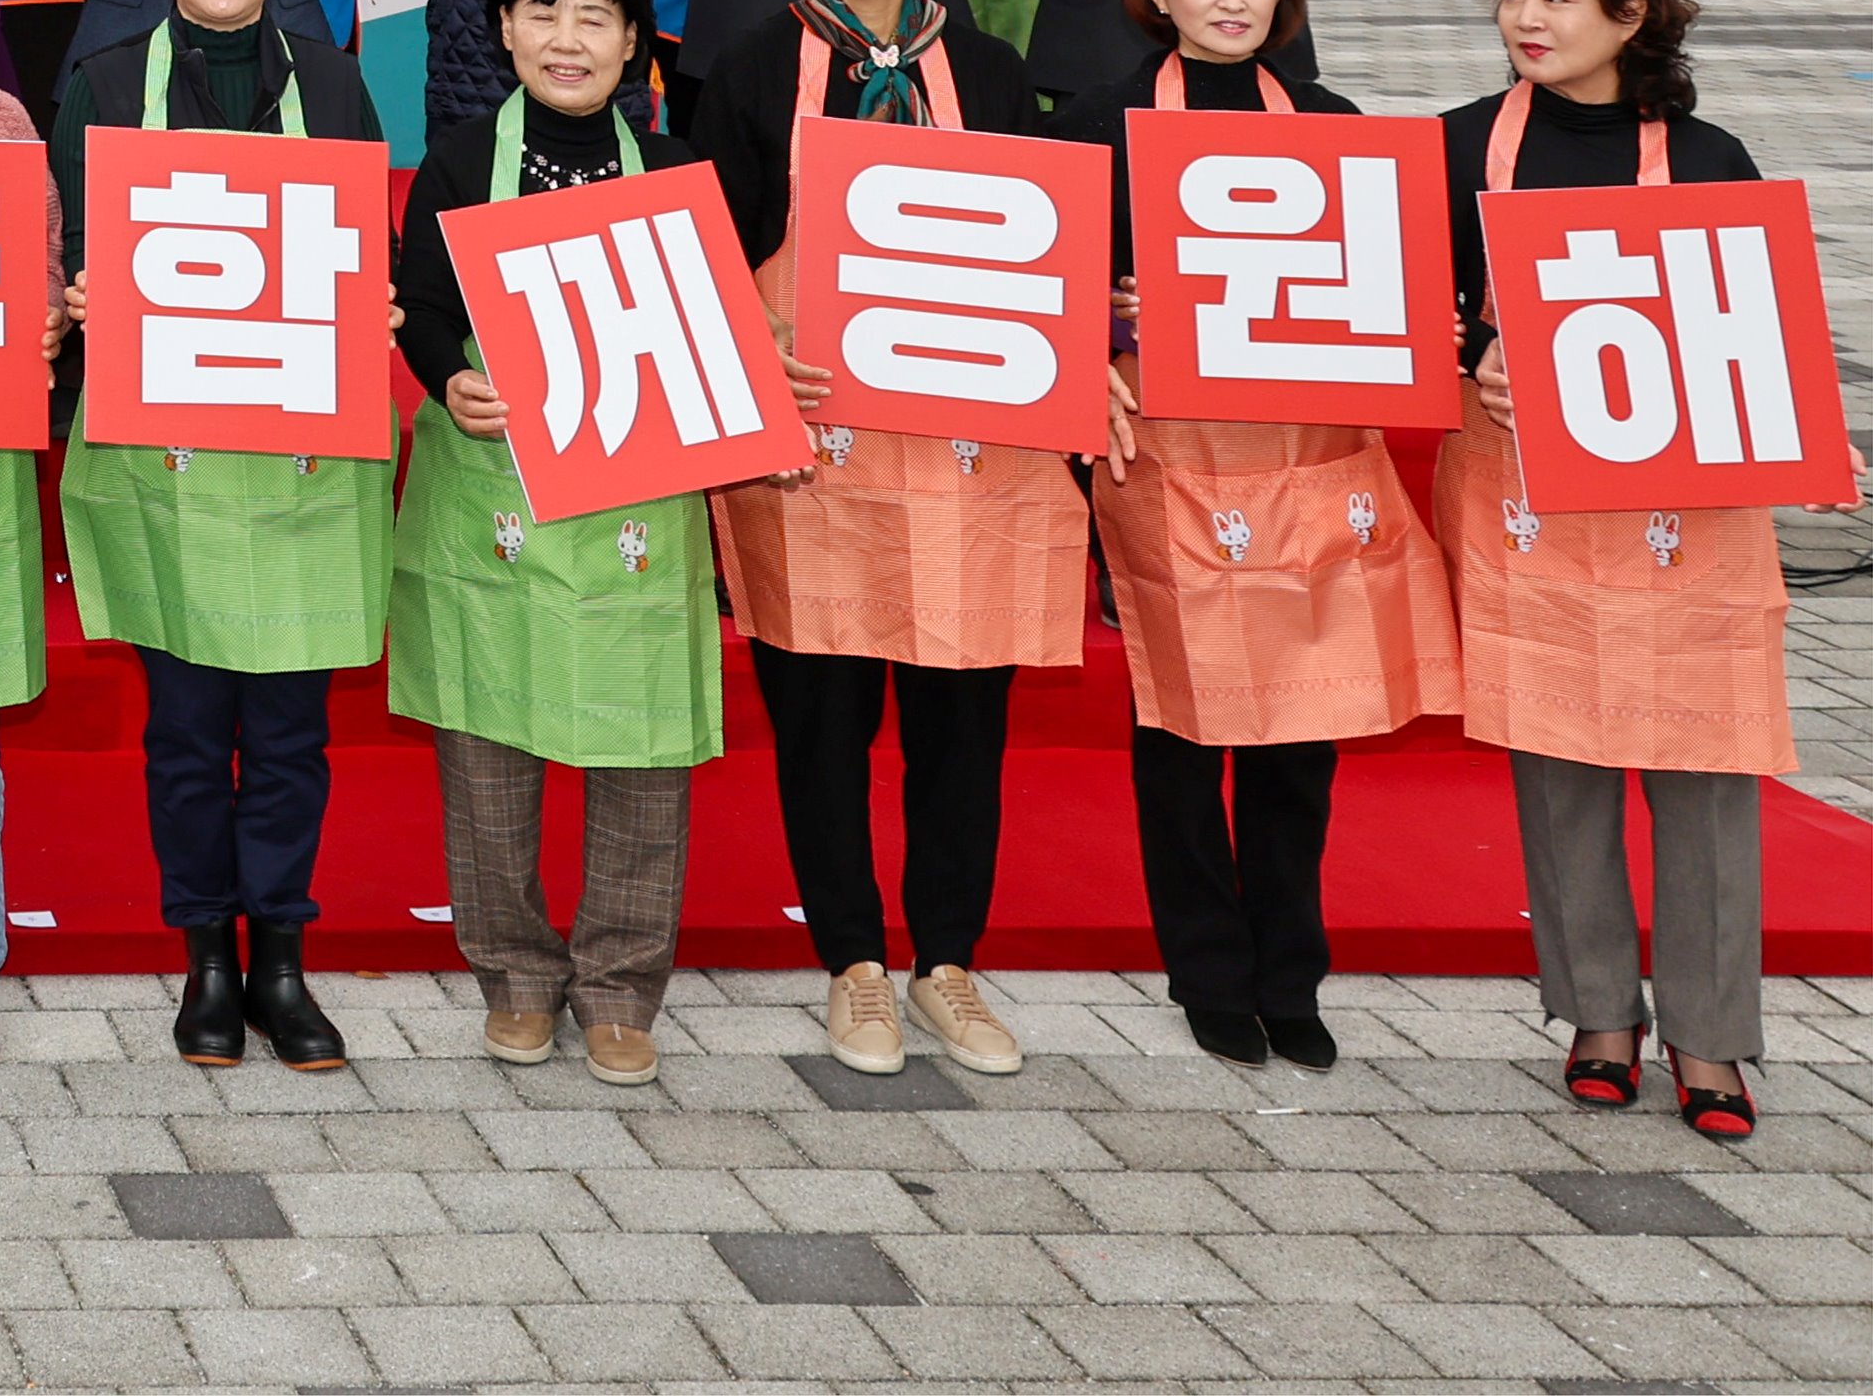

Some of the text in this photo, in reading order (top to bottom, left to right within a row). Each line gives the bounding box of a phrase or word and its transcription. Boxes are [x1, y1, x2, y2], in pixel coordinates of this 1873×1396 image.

[131, 172, 359, 413] 함
[497, 210, 763, 453] 께
[839, 165, 1062, 404] 응
[1178, 156, 1412, 384] 원
[1537, 227, 1801, 463] 해
